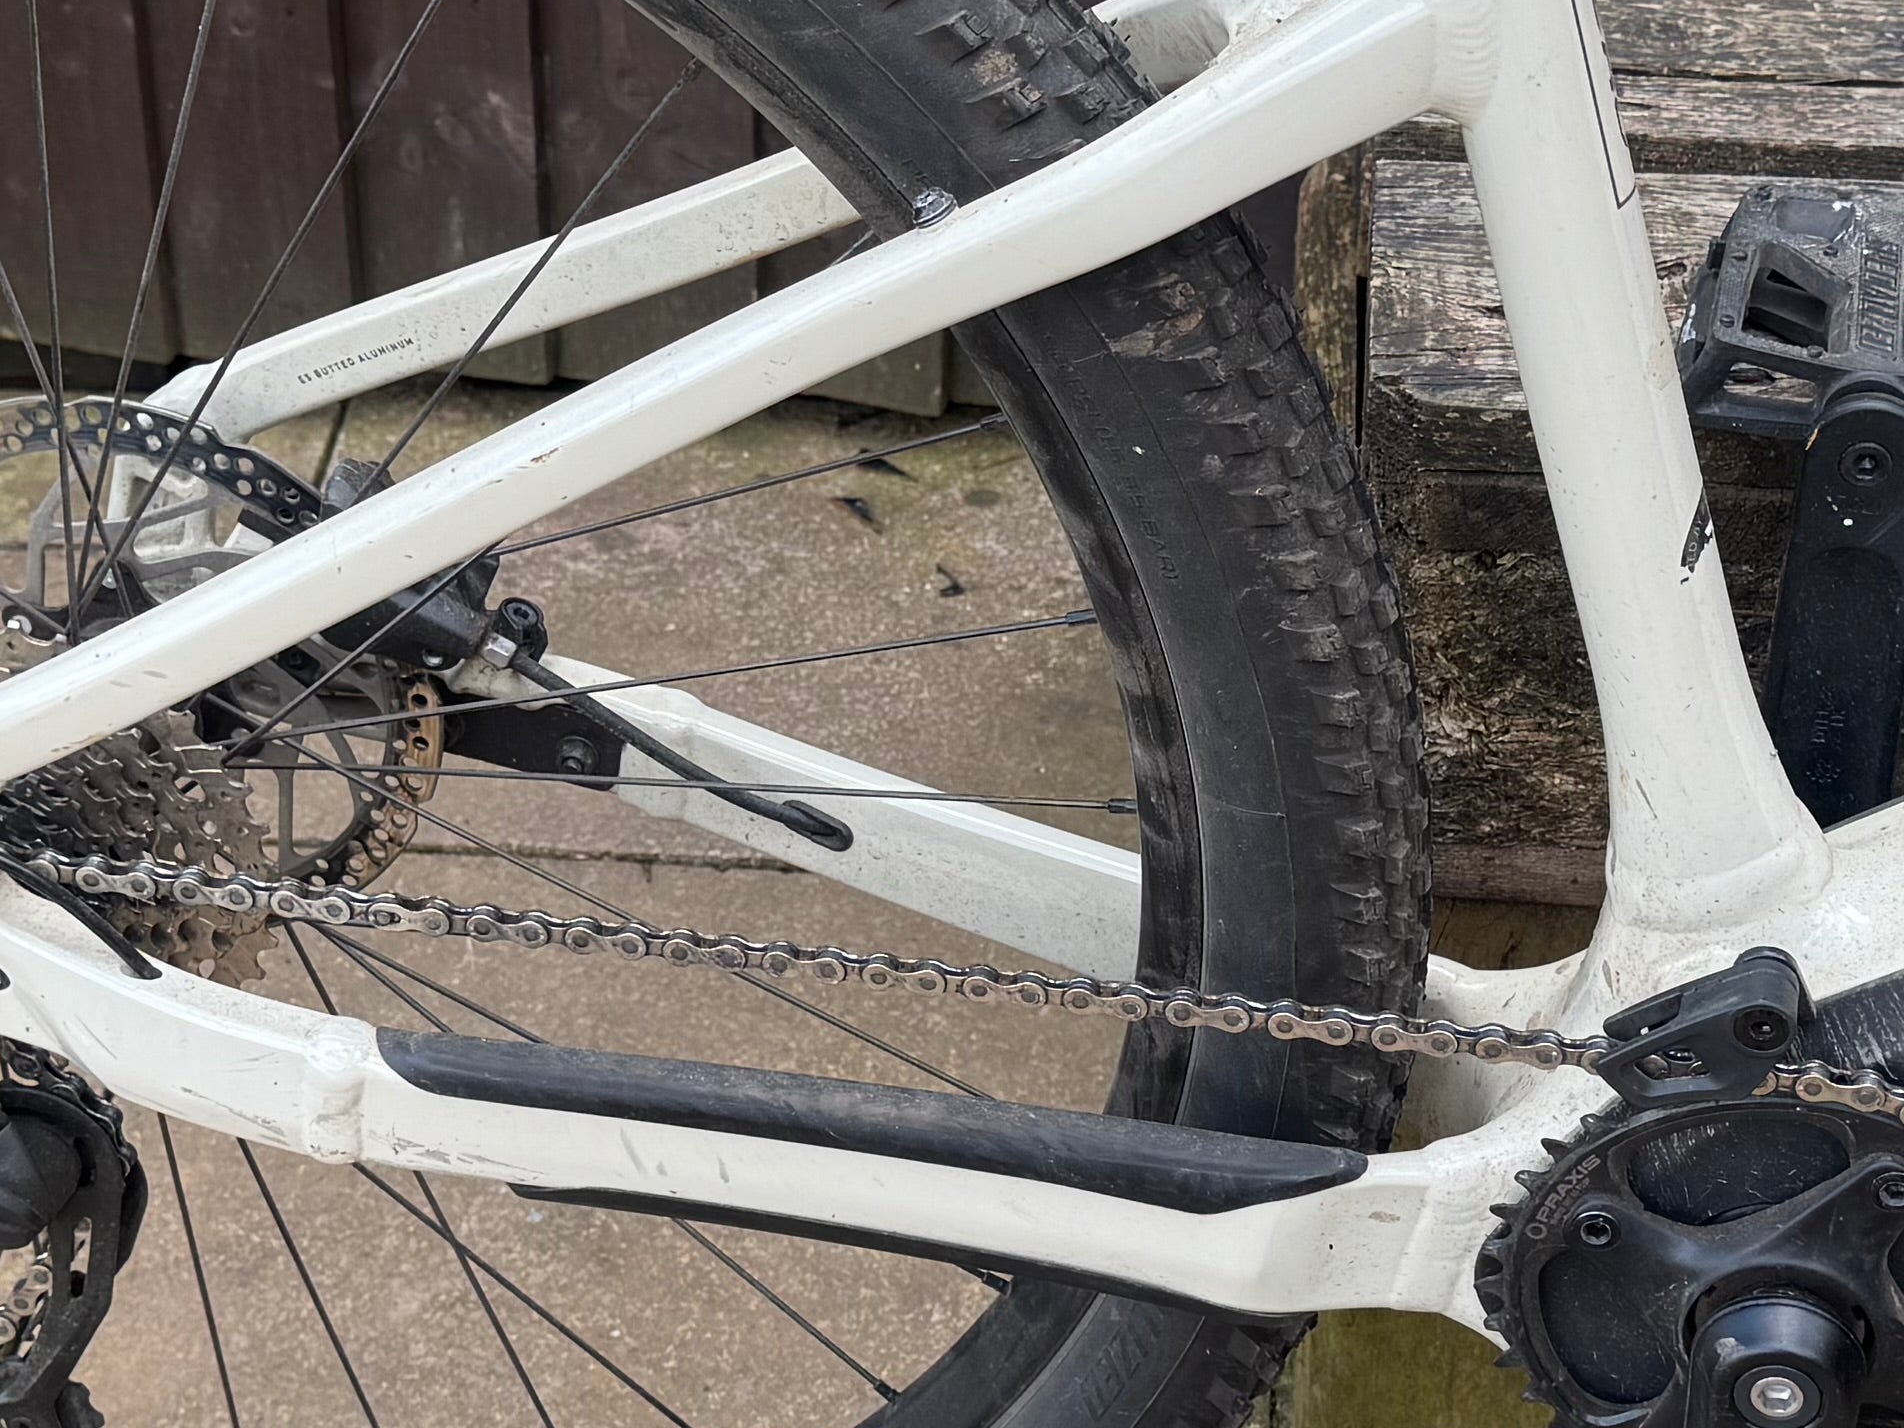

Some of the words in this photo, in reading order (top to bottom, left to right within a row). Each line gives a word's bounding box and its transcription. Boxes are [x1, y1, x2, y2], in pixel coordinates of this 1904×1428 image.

[313, 356, 356, 379] BUTTED
[357, 337, 415, 364] ALUMINUM
[1536, 1154, 1602, 1223] PRAXIS
